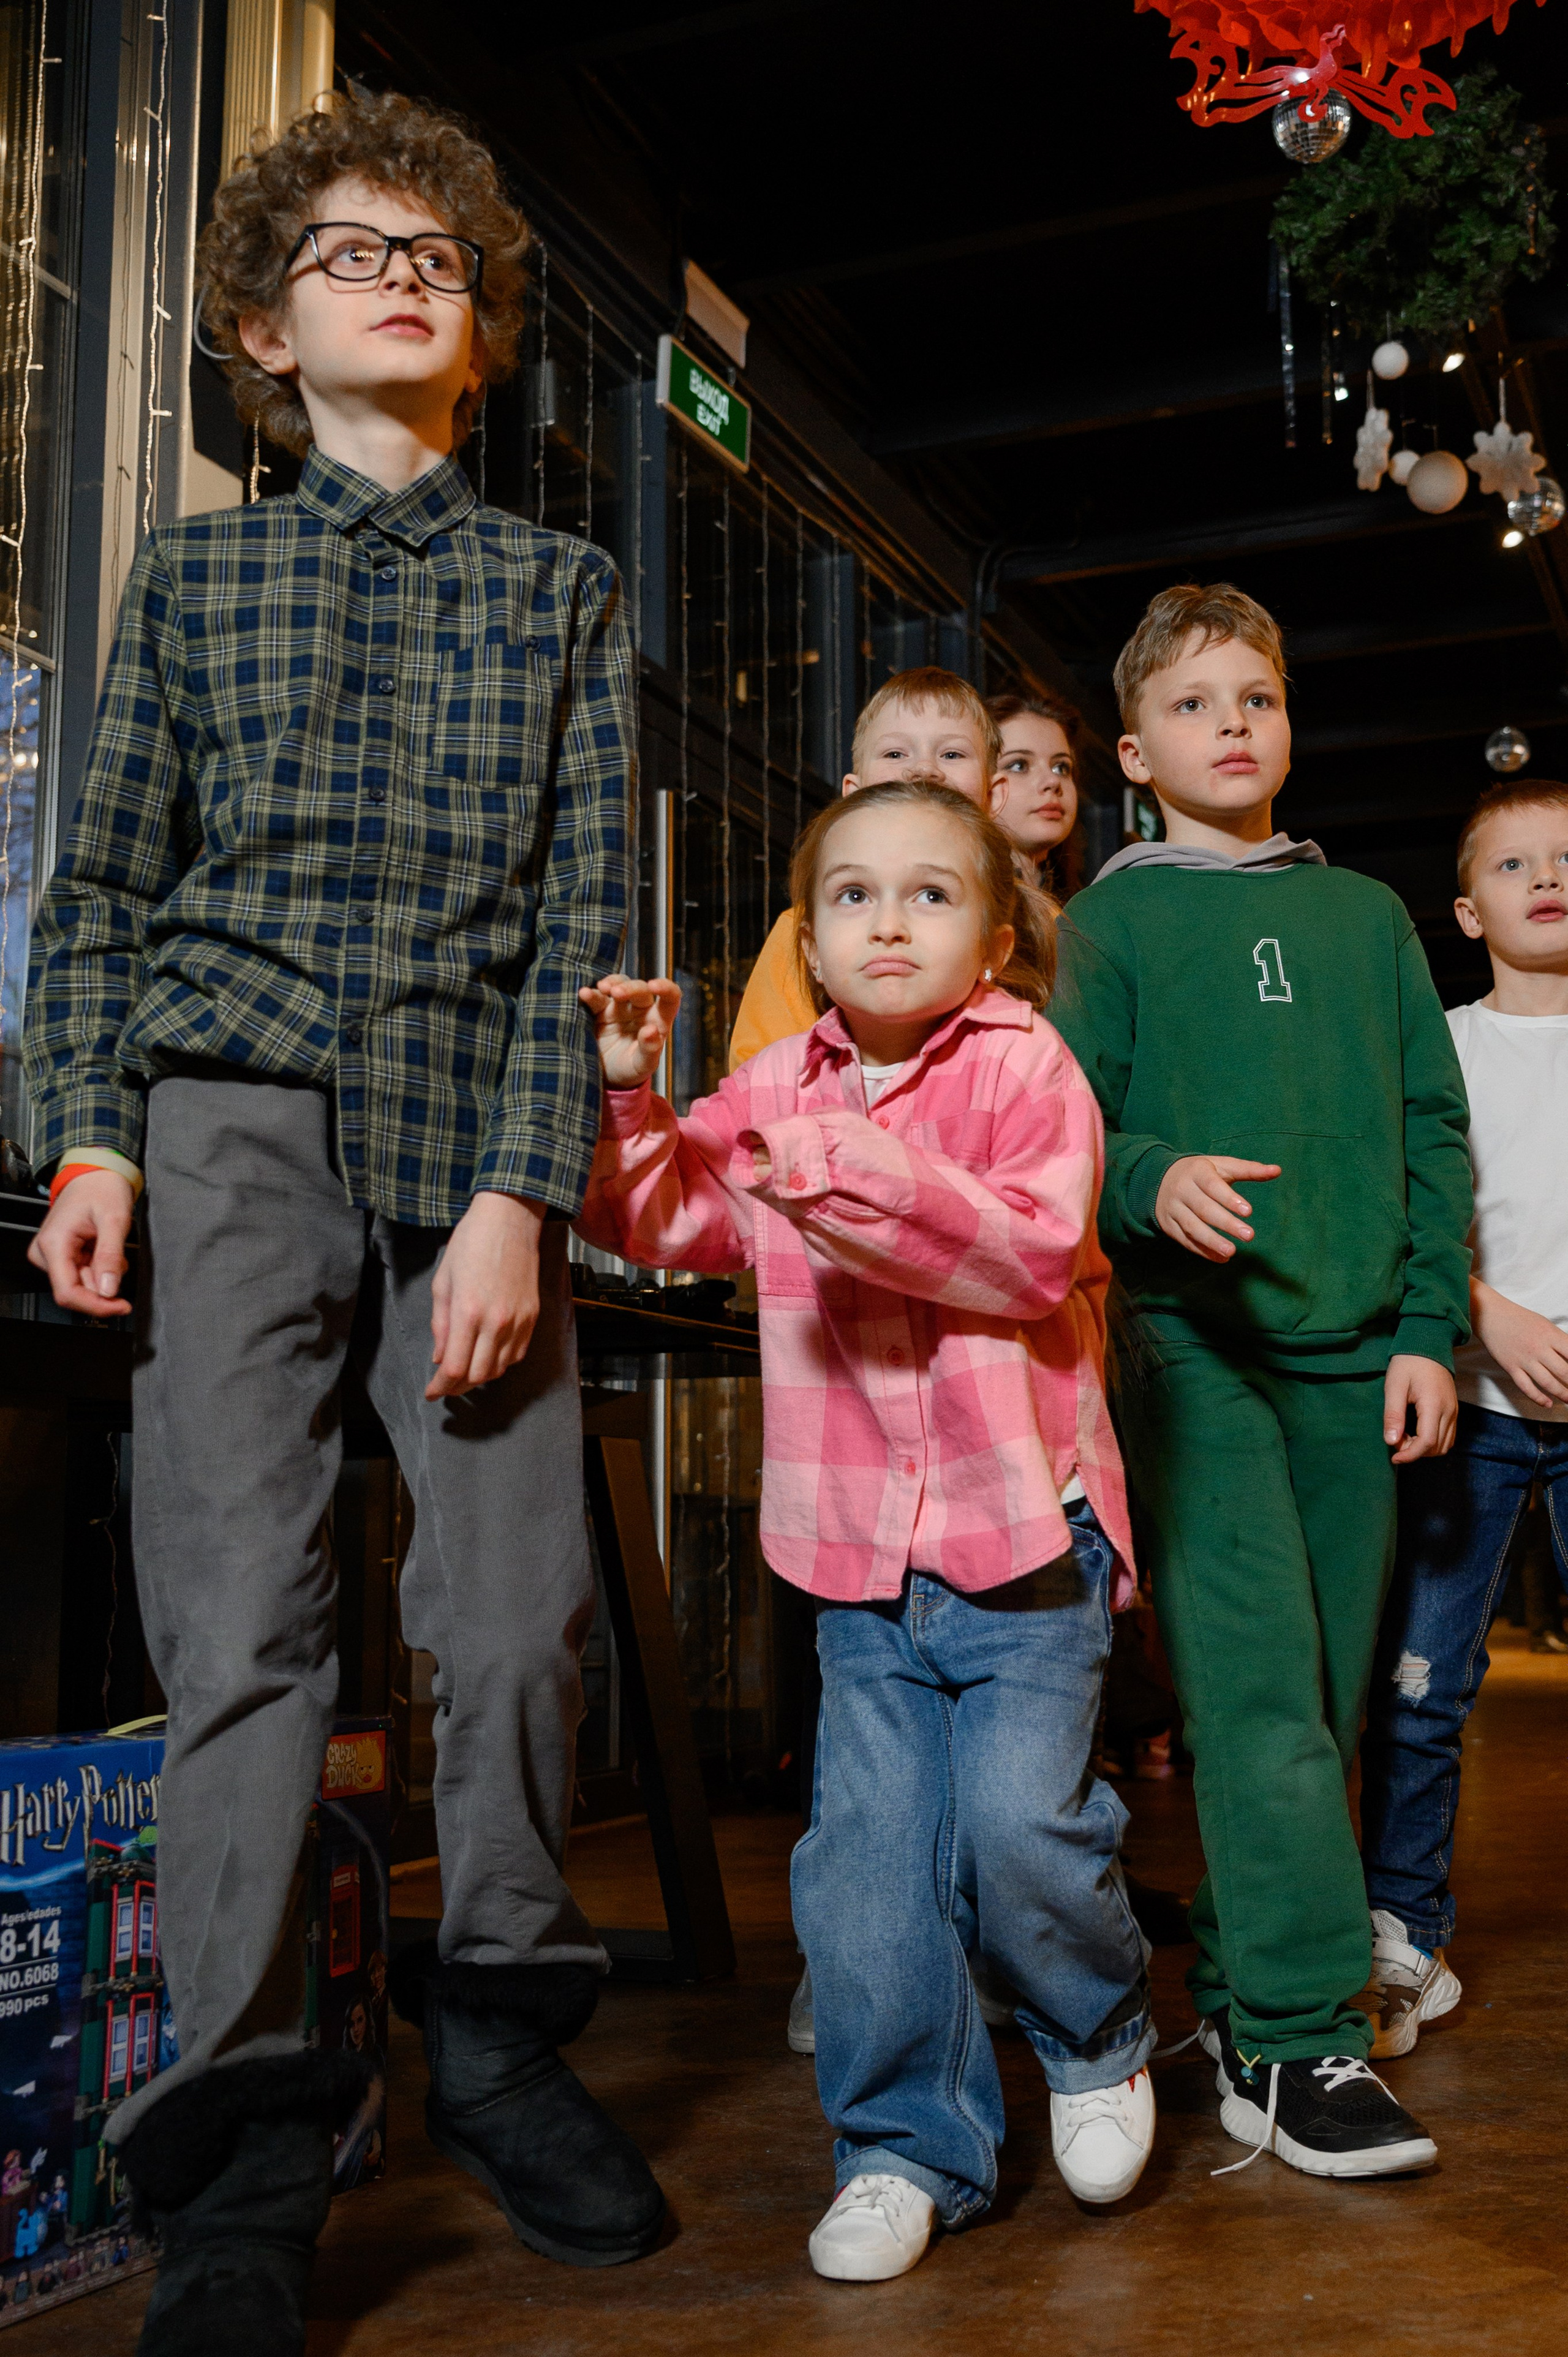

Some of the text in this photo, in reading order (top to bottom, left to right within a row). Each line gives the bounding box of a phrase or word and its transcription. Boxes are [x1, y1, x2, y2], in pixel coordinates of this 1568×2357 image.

[689, 368, 729, 426] ВЫХОД
[696, 402, 722, 436] EXIT
[1253, 938, 1292, 1003] 1
[326, 1743, 356, 1765] CRAZY
[326, 1763, 363, 1789] DUCK
[0, 1763, 160, 1869] Harry Potter
[0, 1918, 61, 1964] 8-14
[0, 1961, 59, 1991] NO.6068
[24, 1994, 50, 2013] pcs
